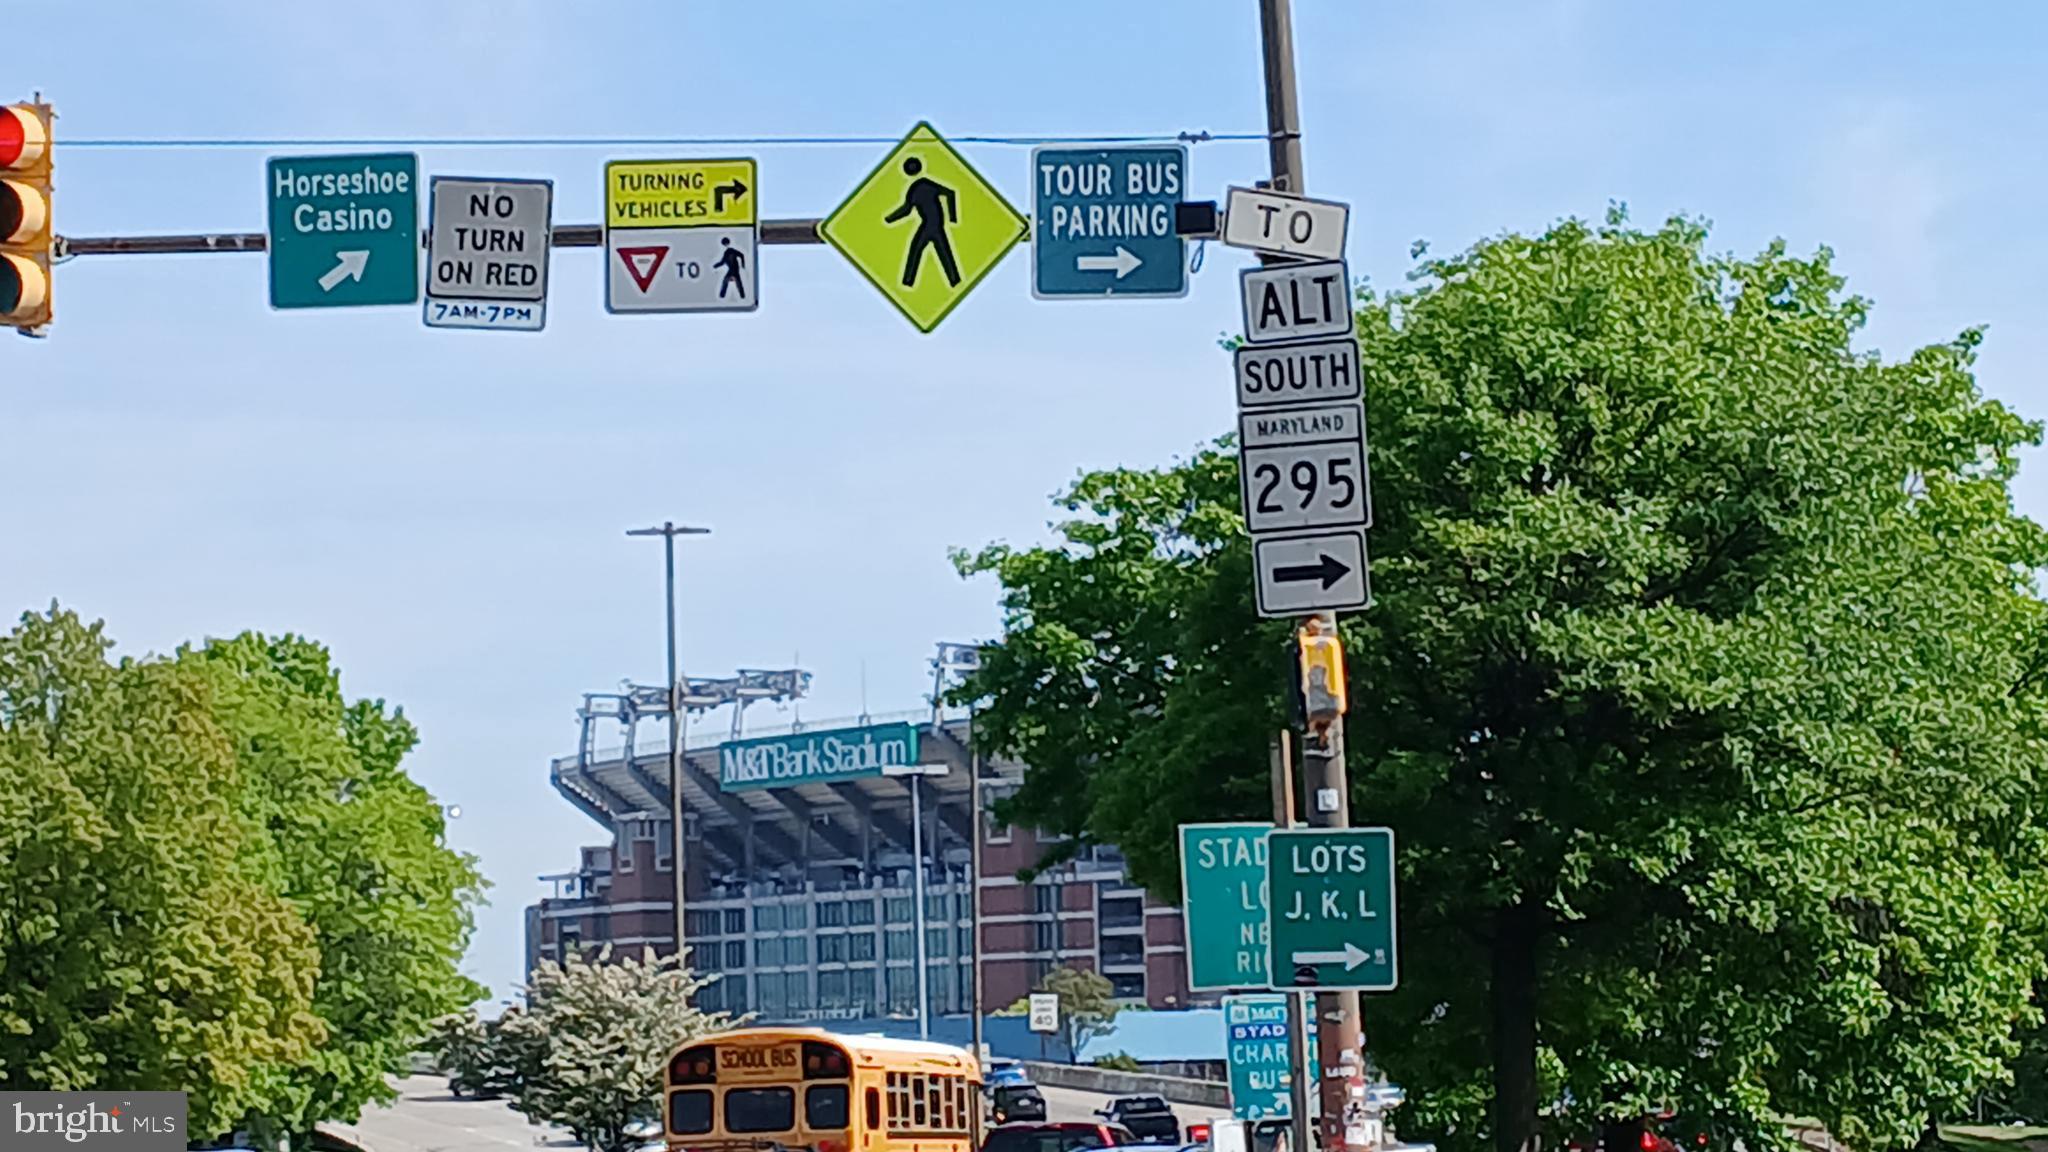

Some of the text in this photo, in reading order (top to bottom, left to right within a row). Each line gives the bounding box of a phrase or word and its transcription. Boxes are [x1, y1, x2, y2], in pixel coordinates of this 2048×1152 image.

[275, 166, 409, 198] Horseshoe
[618, 173, 705, 191] TURNING
[1041, 162, 1179, 196] TOUR BUS
[294, 202, 392, 233] Casino
[469, 194, 514, 217] NO
[615, 199, 708, 219] VEHICLES
[1052, 205, 1168, 240] PARKING
[1257, 205, 1313, 243] TO
[455, 228, 524, 252] TURN
[438, 261, 538, 287] ON RED
[676, 262, 700, 279] TO
[434, 304, 532, 321] 7AM-7PM
[1260, 276, 1338, 329] ALT
[1244, 352, 1350, 393] SOUTH
[1257, 415, 1344, 437] MARYLAND
[1254, 458, 1355, 514] 295
[724, 733, 906, 783] M&T Bank Stadium
[1198, 837, 1268, 868] STAD
[1292, 845, 1367, 873] LOTS
[1241, 880, 1268, 911] LO
[1358, 890, 1377, 917] L
[721, 1048, 797, 1069] SCHOOL BUS
[1232, 1043, 1288, 1066] CHAR
